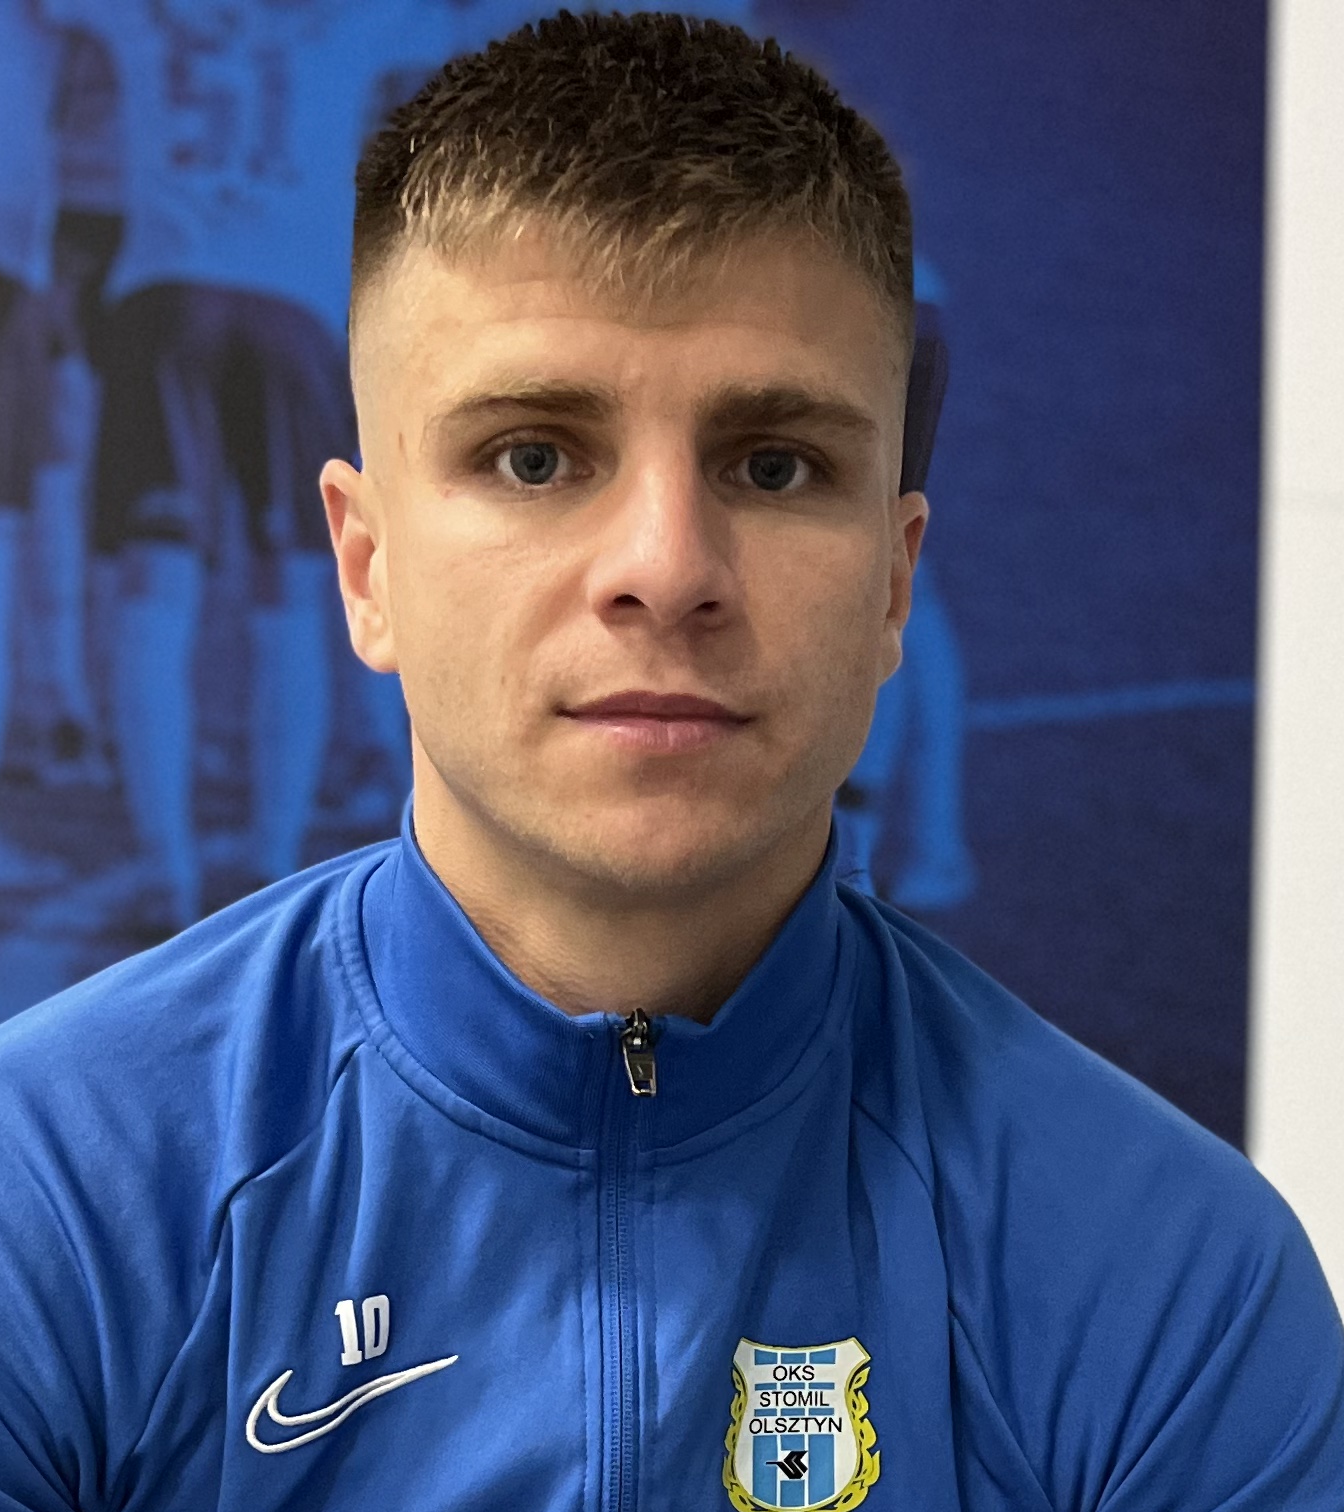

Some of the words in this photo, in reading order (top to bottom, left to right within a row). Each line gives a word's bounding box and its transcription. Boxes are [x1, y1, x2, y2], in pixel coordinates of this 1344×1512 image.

[334, 1294, 390, 1366] 10
[772, 1364, 815, 1381] OKS
[759, 1390, 830, 1407] STOMIL
[748, 1417, 843, 1434] OLSZTYN
